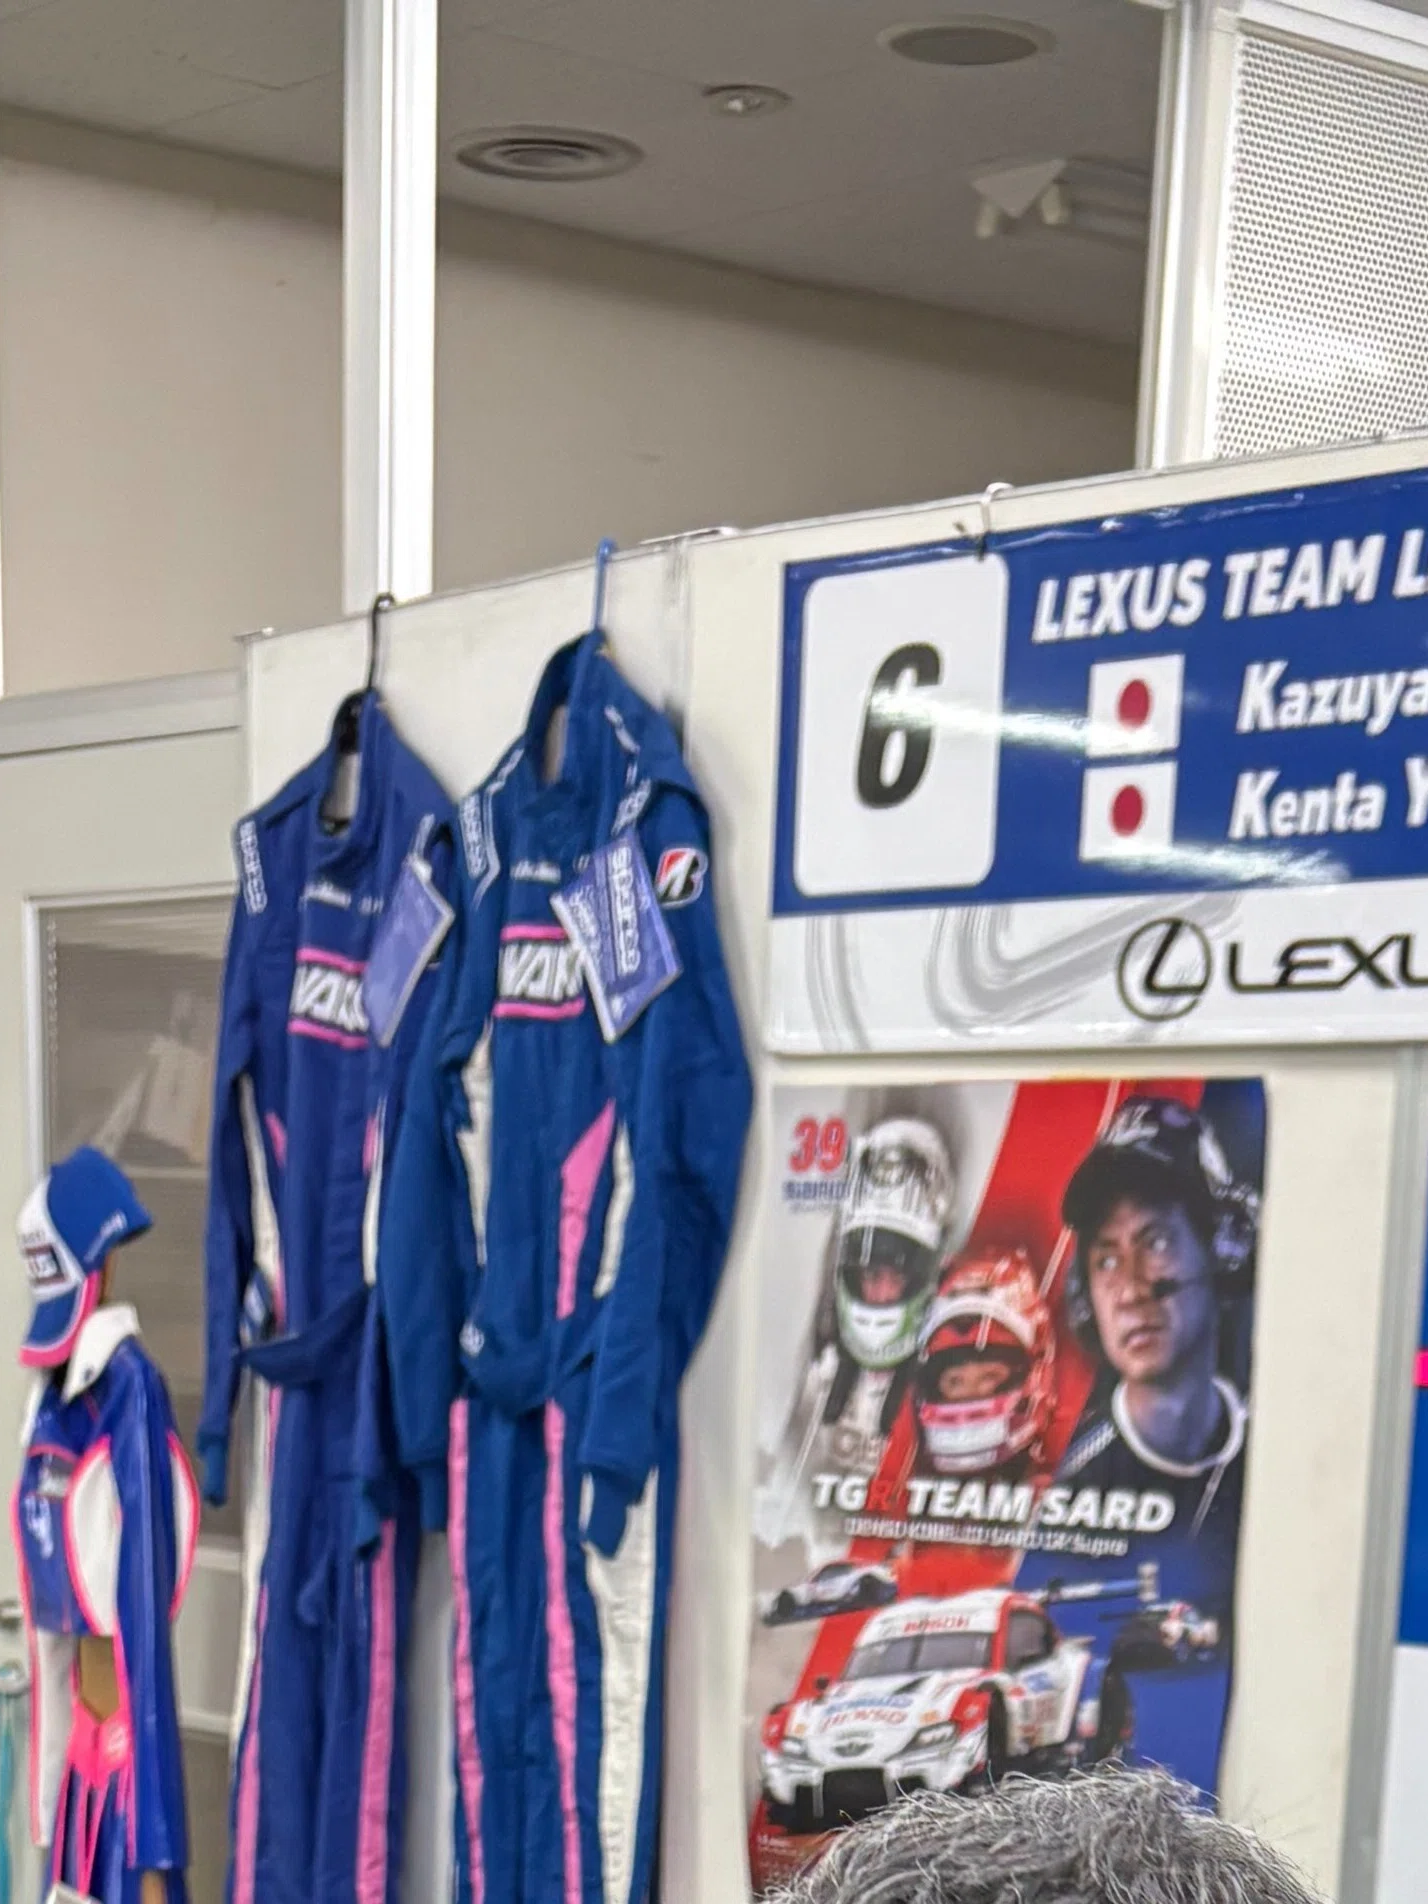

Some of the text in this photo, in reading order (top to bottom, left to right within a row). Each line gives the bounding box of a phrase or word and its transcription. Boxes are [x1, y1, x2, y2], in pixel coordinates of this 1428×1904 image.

[1031, 557, 1211, 645] LEXUS
[1222, 533, 1386, 621] TEAM
[854, 642, 943, 811] 6
[1227, 769, 1386, 841] Kenta
[788, 1116, 848, 1173] 39
[906, 1477, 1037, 1524] TEAM
[1039, 1487, 1176, 1534] SARD
